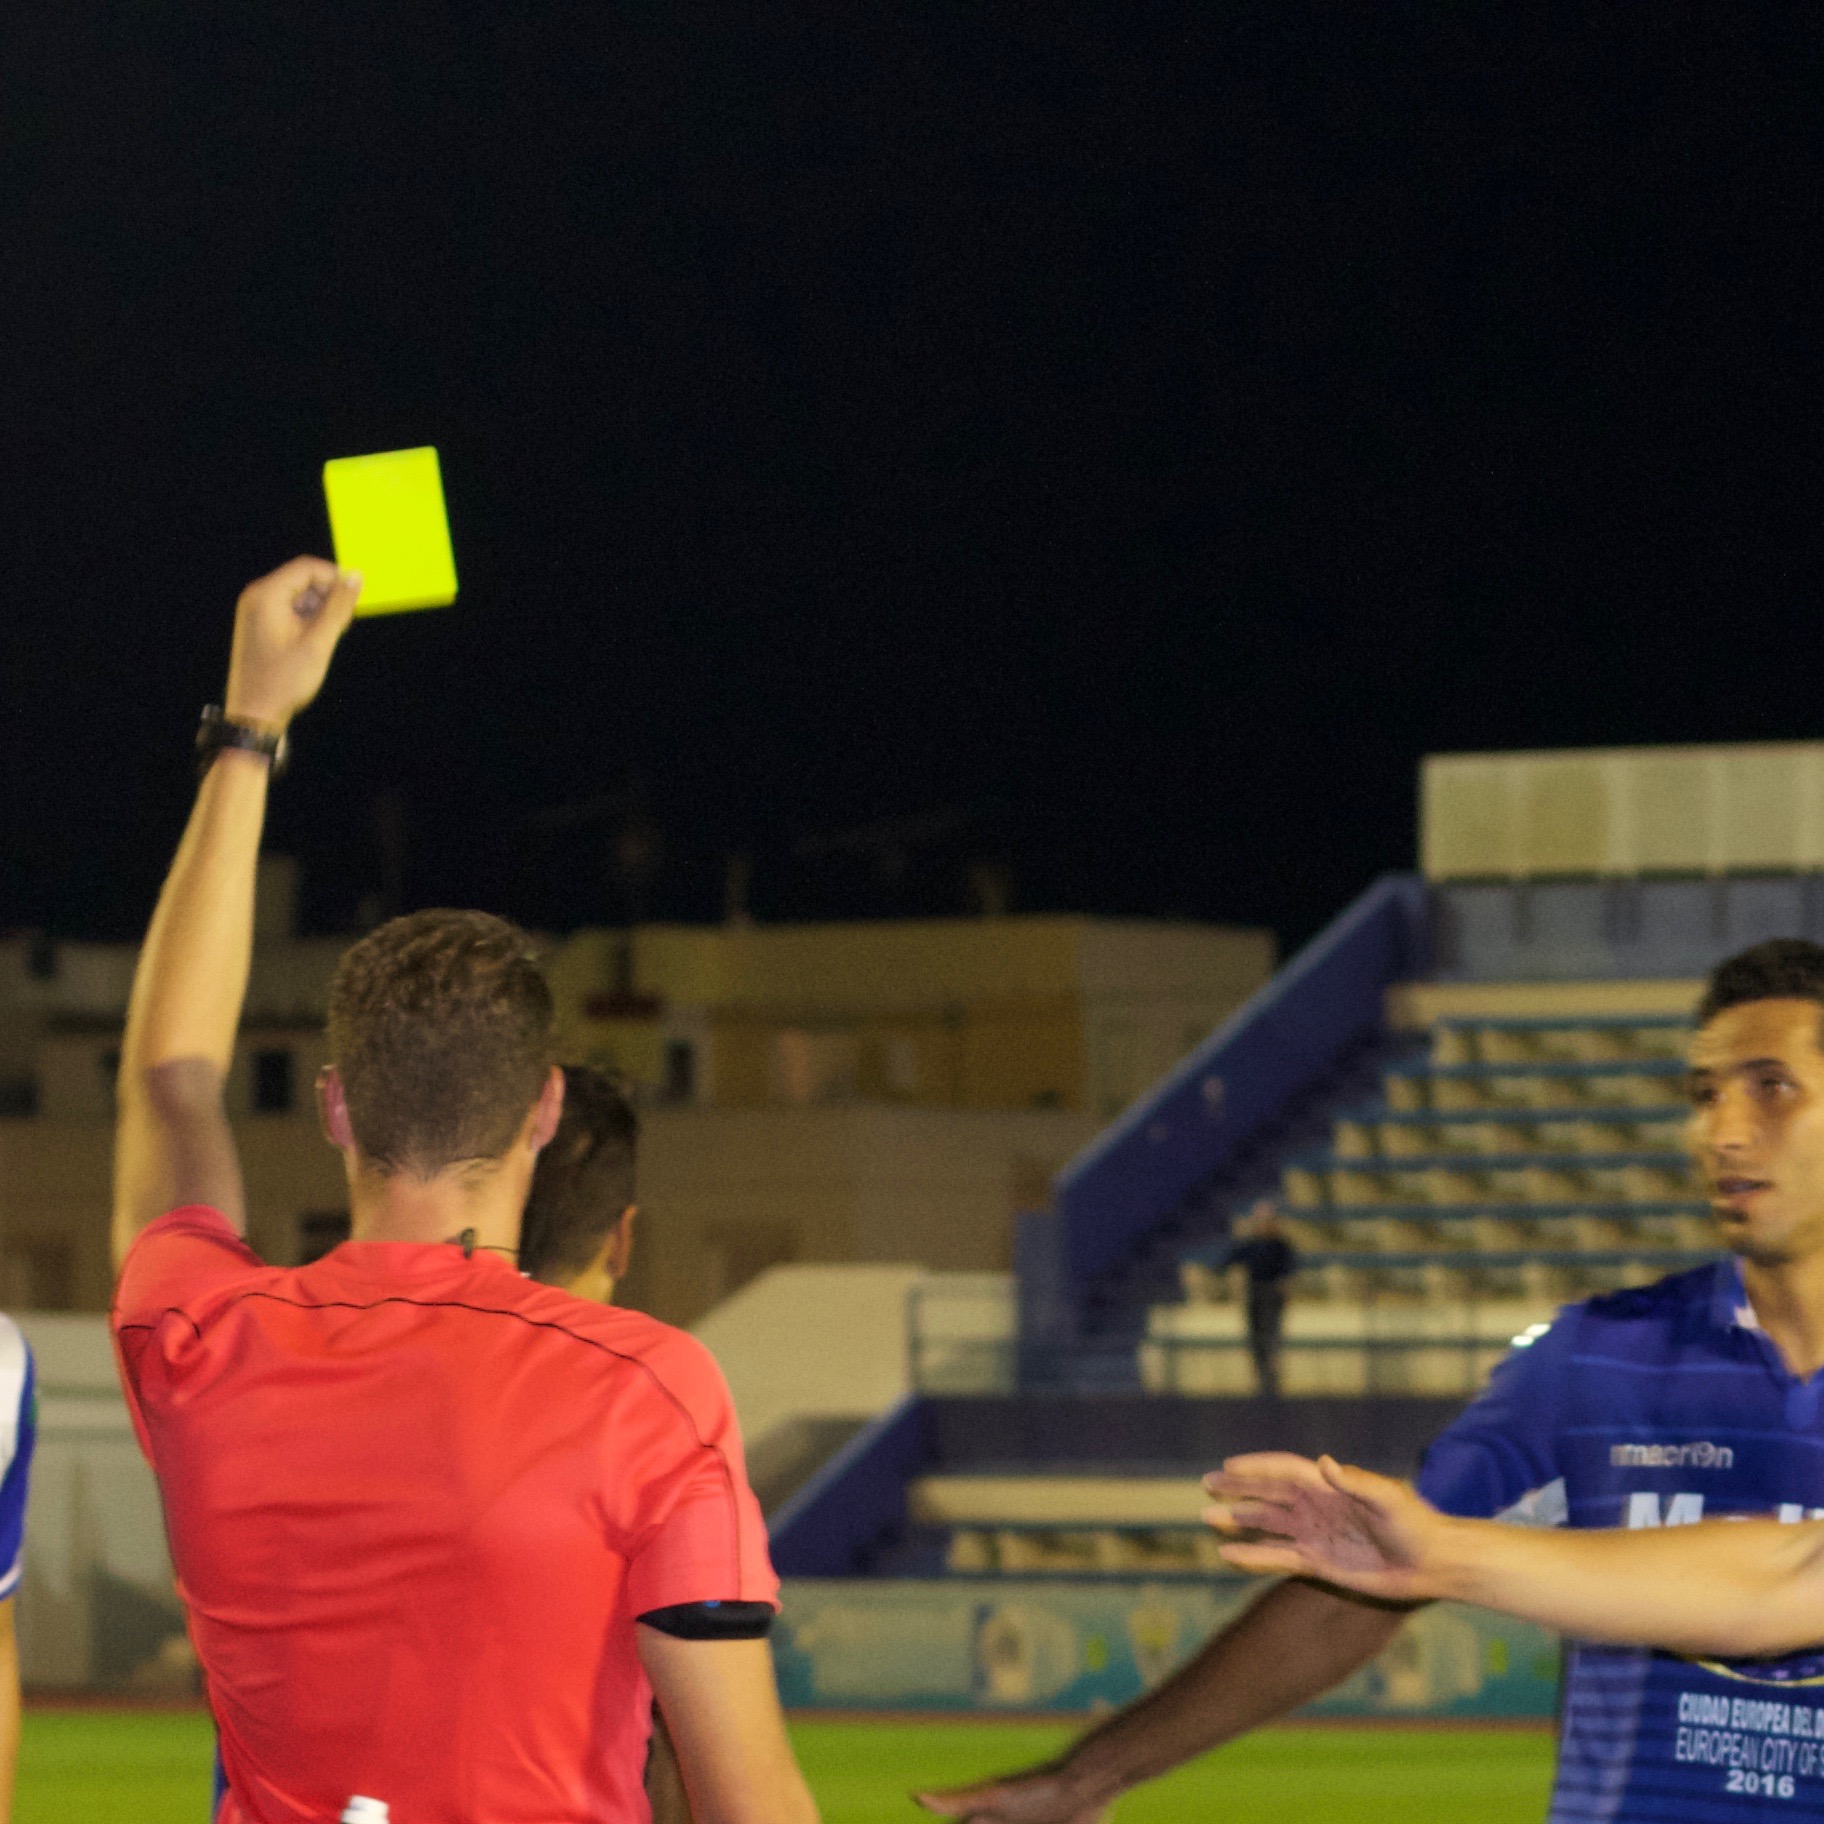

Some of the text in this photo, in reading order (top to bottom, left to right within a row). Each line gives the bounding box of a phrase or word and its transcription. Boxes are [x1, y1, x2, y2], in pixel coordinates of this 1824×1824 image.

[1678, 1692, 1730, 1727] CIUDAD
[1730, 1697, 1791, 1734] EUROPEA
[1792, 1705, 1814, 1738] DEL
[1677, 1727, 1760, 1769] EUROPEAN
[1761, 1737, 1798, 1773] CITY
[1798, 1742, 1818, 1775] OF
[1727, 1769, 1796, 1798] 2016
